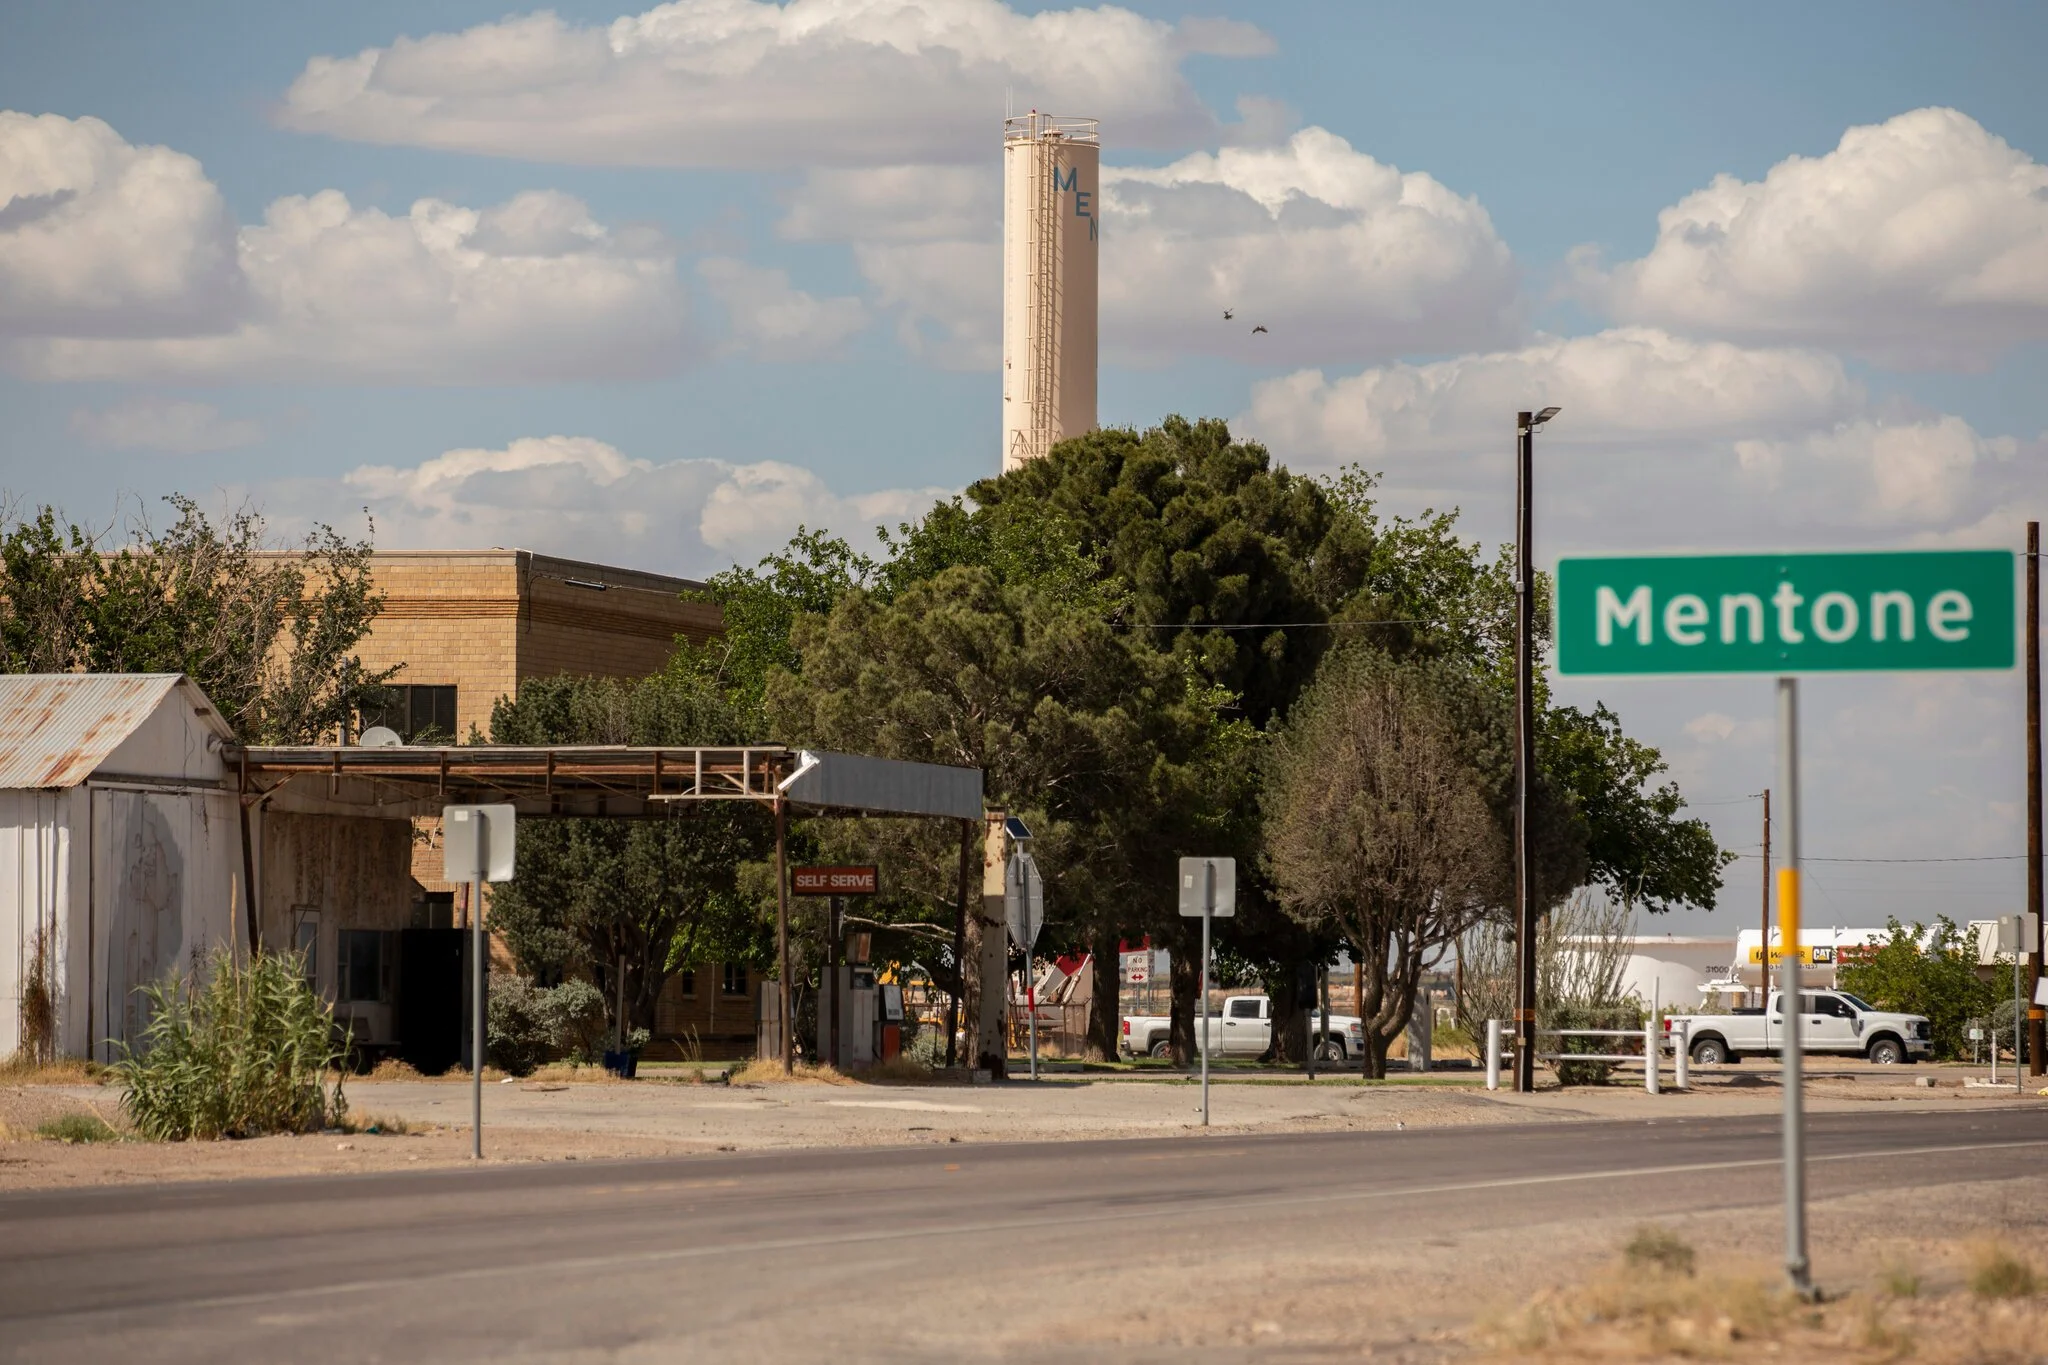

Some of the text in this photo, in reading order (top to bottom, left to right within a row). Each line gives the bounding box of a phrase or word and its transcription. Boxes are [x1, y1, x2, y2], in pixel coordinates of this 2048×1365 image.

[1595, 581, 1974, 646] Mentone
[796, 875, 873, 887] SELF SERVE
[1813, 948, 1831, 961] CAT
